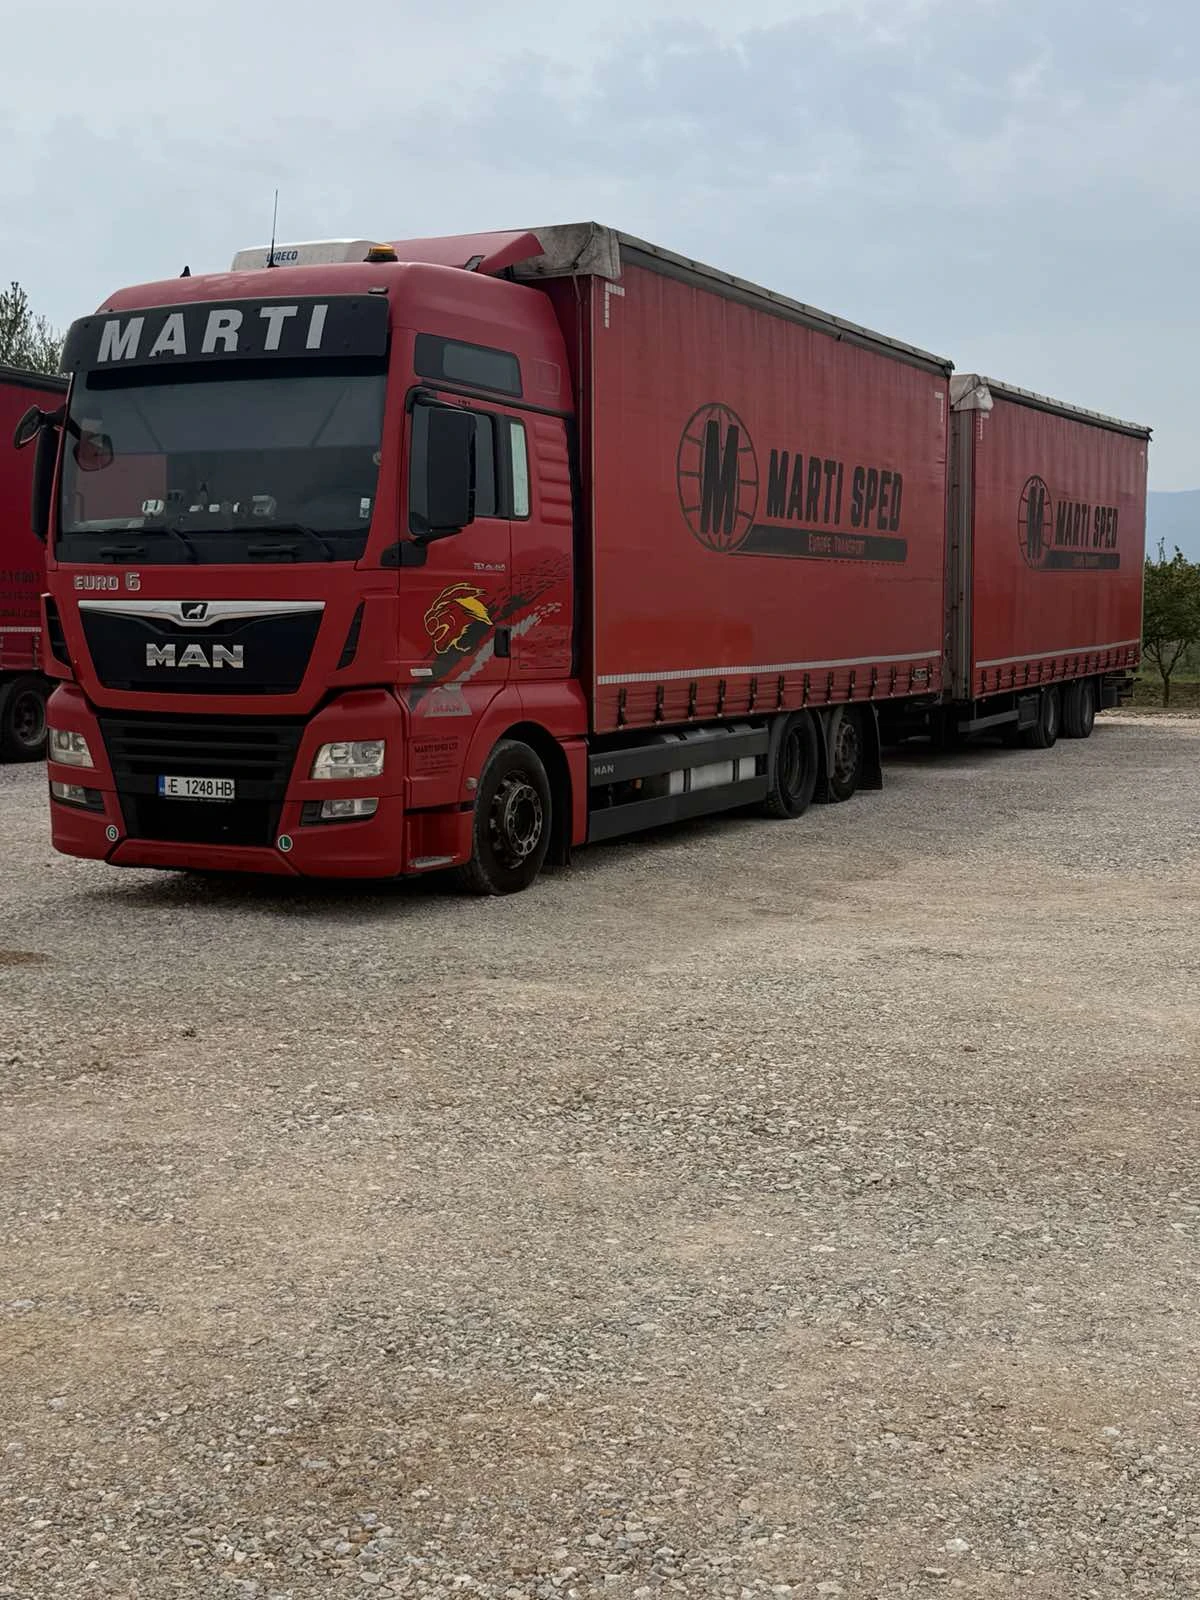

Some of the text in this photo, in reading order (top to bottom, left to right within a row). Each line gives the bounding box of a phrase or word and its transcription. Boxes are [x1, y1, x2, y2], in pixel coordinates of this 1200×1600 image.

[97, 304, 329, 363] MARTI
[700, 419, 739, 535] M
[766, 448, 904, 532] MARTI SPED
[1055, 500, 1118, 549] MARTI SPED
[73, 571, 141, 592] EURO 6
[145, 643, 244, 669] MAN
[170, 778, 233, 797] E 1248 HB
